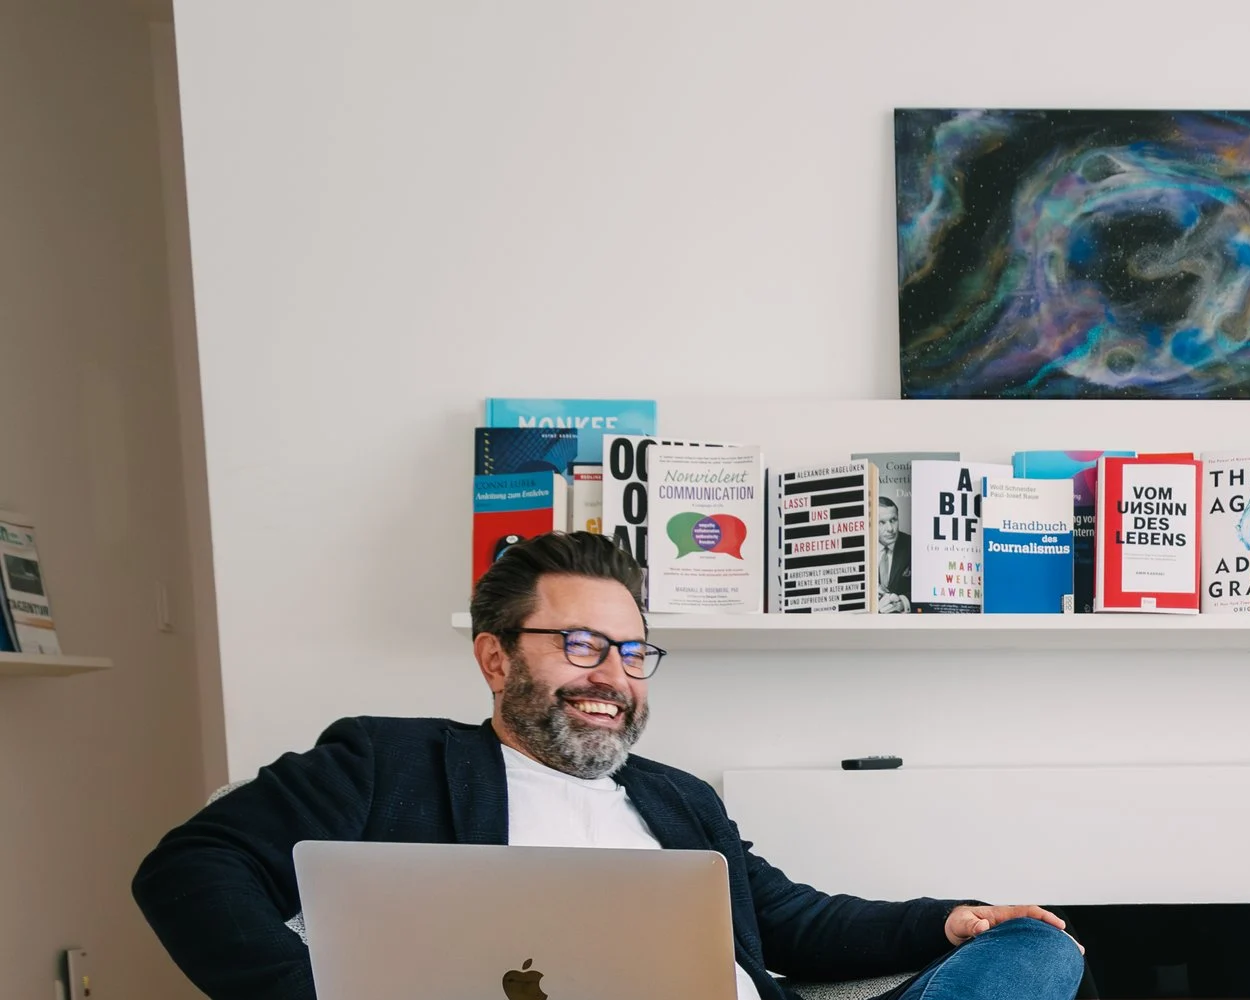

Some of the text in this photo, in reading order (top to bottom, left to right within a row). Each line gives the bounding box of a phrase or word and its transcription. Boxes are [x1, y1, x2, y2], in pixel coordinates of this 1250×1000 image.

[664, 468, 749, 484] Nonviolent
[797, 464, 865, 478] ALEXANDER HAGELÜKEN
[957, 468, 973, 492] A
[658, 485, 754, 501] COMMUNICATION
[1005, 484, 1036, 493] Schneider
[1133, 486, 1172, 500] VOM
[784, 497, 808, 510] LASST
[811, 510, 828, 522] UNS
[1002, 520, 1067, 531] Handbuch
[1133, 517, 1170, 530] DES
[1041, 535, 1058, 543] des
[1115, 531, 1187, 547] LEBENS
[794, 539, 840, 554] ARBEITEN!
[988, 541, 1070, 554] Journalismus
[948, 561, 981, 572] MARY
[798, 578, 832, 587] RENTE RETTEN
[830, 585, 844, 593] ALTER
[845, 583, 859, 591] AKTIV
[801, 596, 828, 605] ZUFRIEDEN
